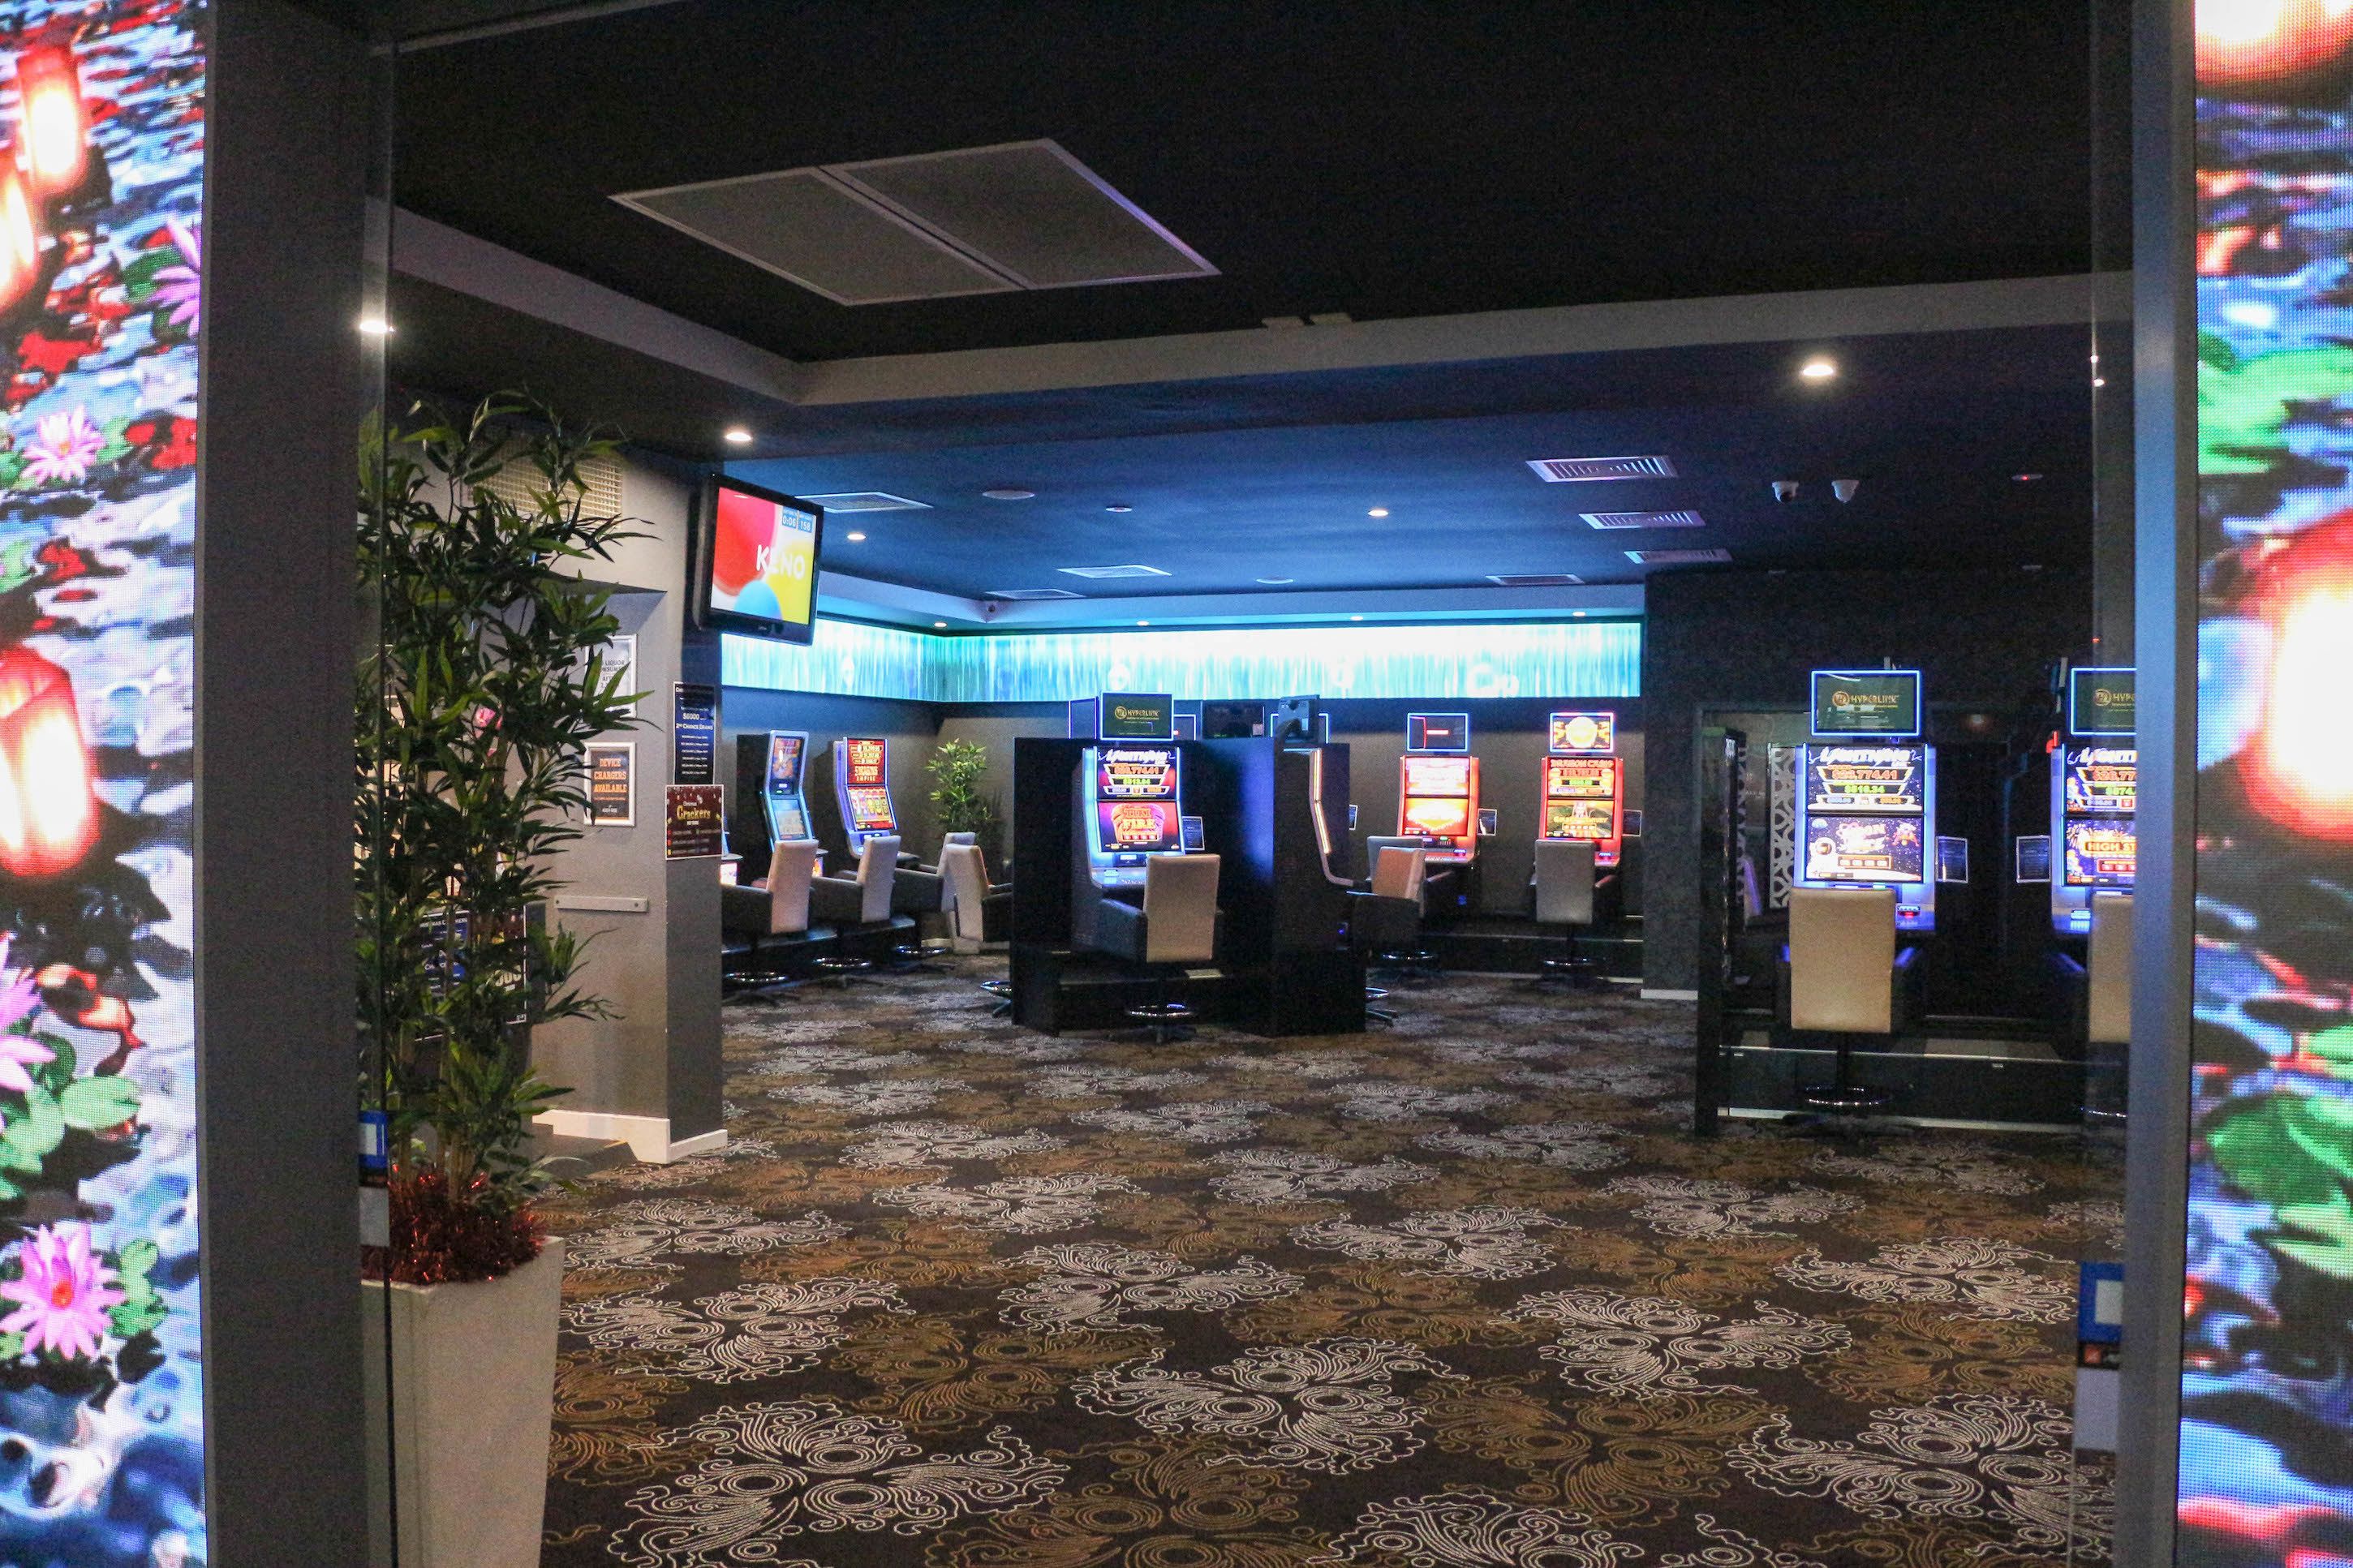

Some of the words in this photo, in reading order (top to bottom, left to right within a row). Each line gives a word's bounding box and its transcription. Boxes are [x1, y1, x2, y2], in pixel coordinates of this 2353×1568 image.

[756, 544, 806, 580] KENO
[1851, 694, 1897, 703] HYPERLINK
[600, 758, 622, 767] DEVICE
[593, 771, 627, 780] CHARGERS
[593, 784, 628, 793] AVAILABLE
[677, 804, 711, 820] Crackers
[2088, 842, 2120, 851] HIGH
